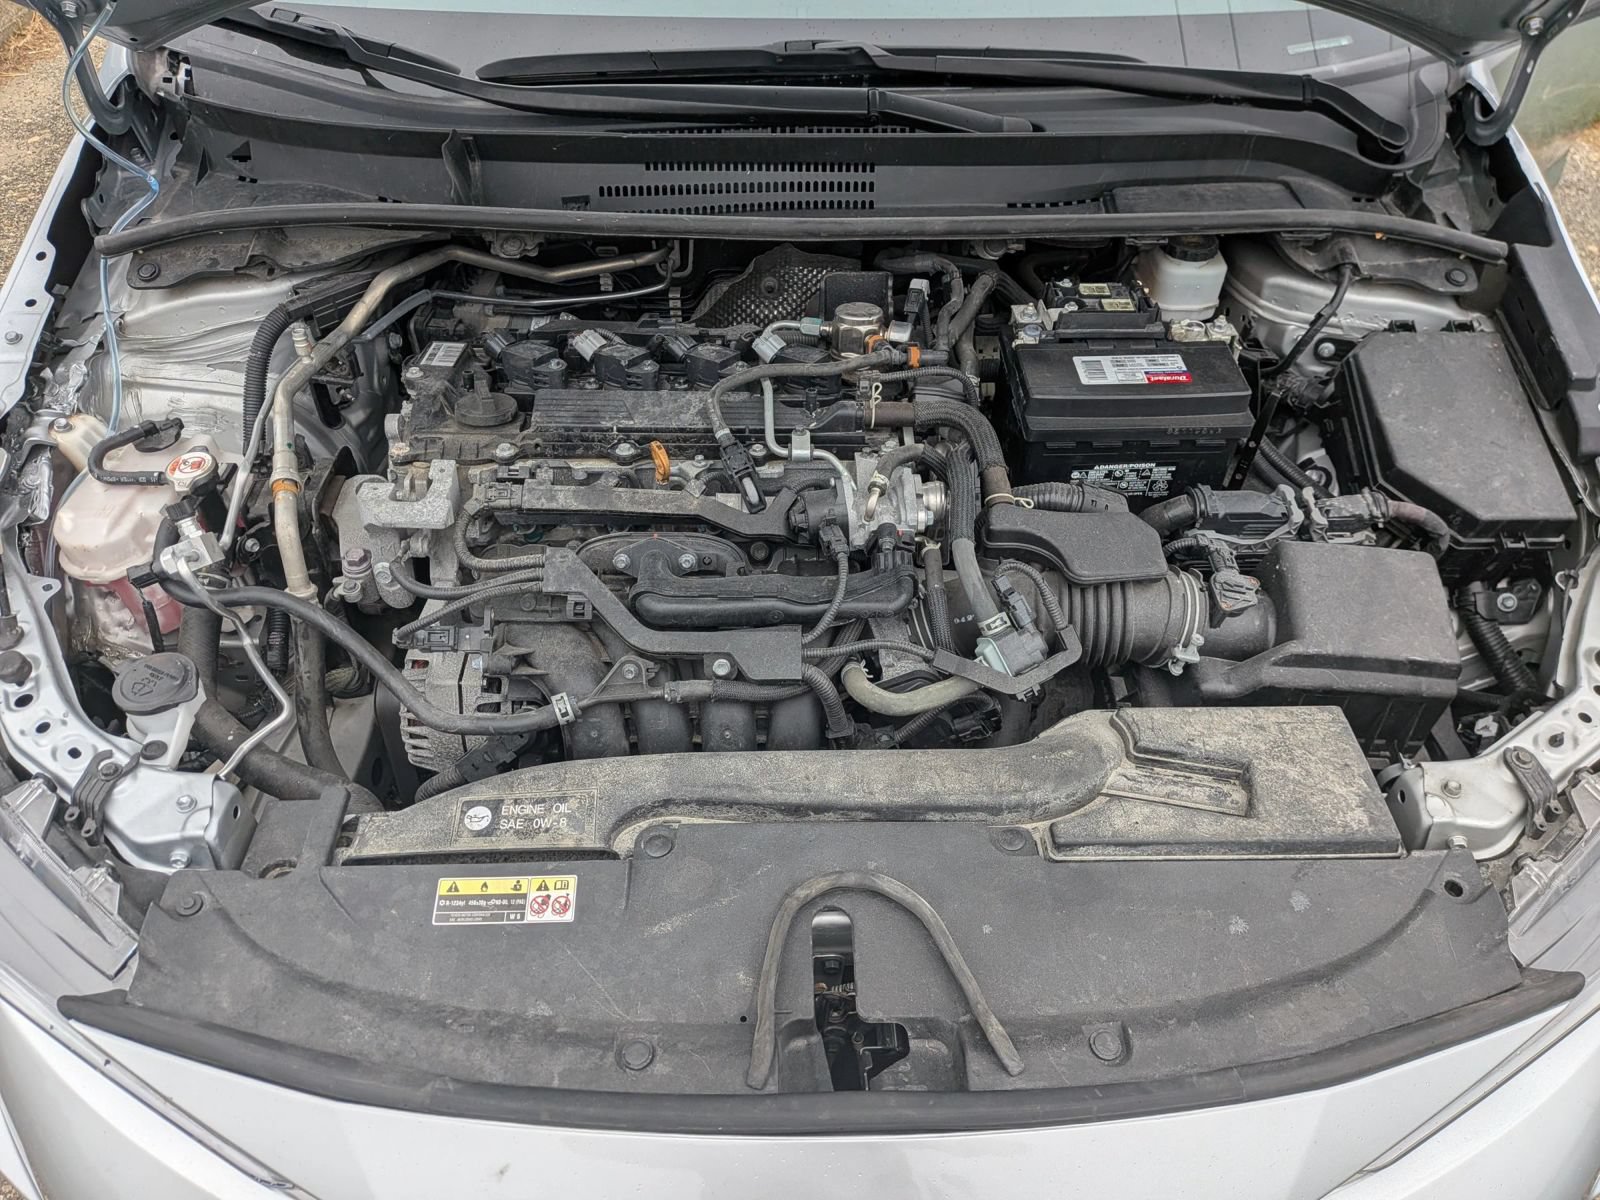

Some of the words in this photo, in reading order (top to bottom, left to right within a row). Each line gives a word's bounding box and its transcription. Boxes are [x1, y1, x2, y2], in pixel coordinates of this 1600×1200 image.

[501, 804, 545, 815] ENGINE
[553, 802, 572, 813] OIL
[500, 818, 525, 829] SAE
[533, 817, 567, 829] 0W-8
